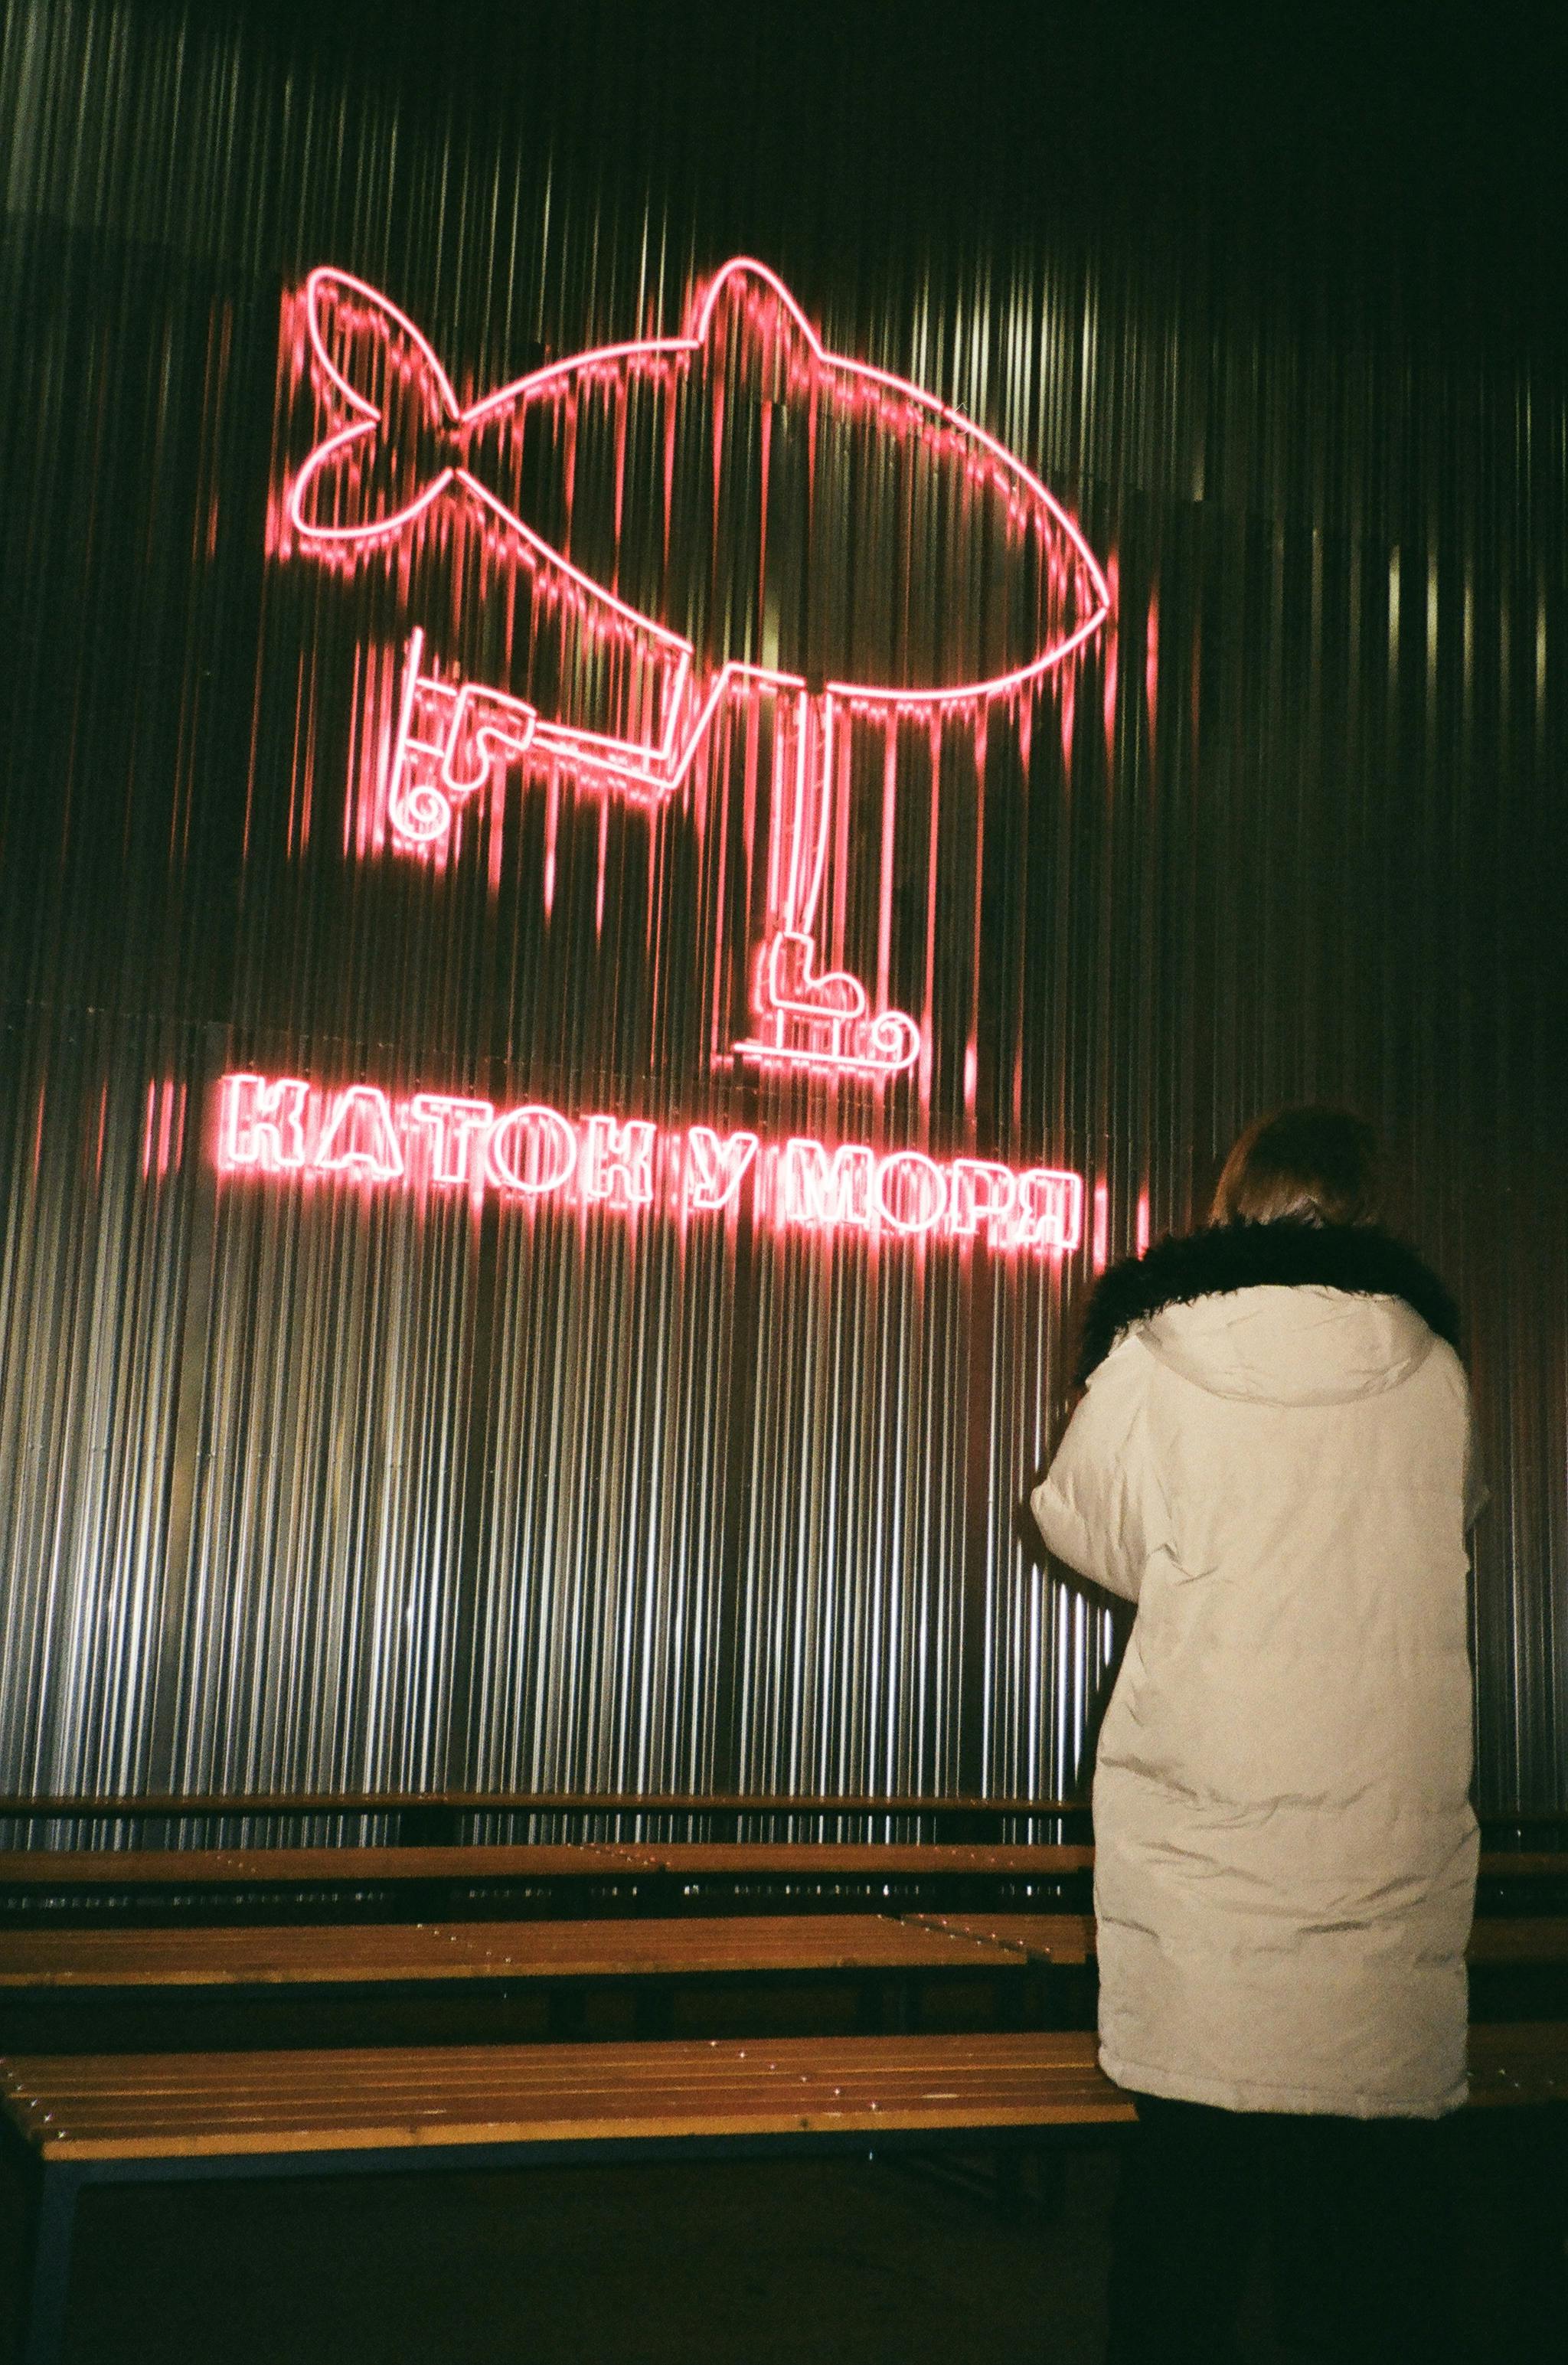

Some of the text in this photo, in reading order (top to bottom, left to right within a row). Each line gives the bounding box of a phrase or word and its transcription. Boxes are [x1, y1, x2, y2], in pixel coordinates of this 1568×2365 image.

[222, 1073, 1082, 1249] КАТОК У МОРЯ
